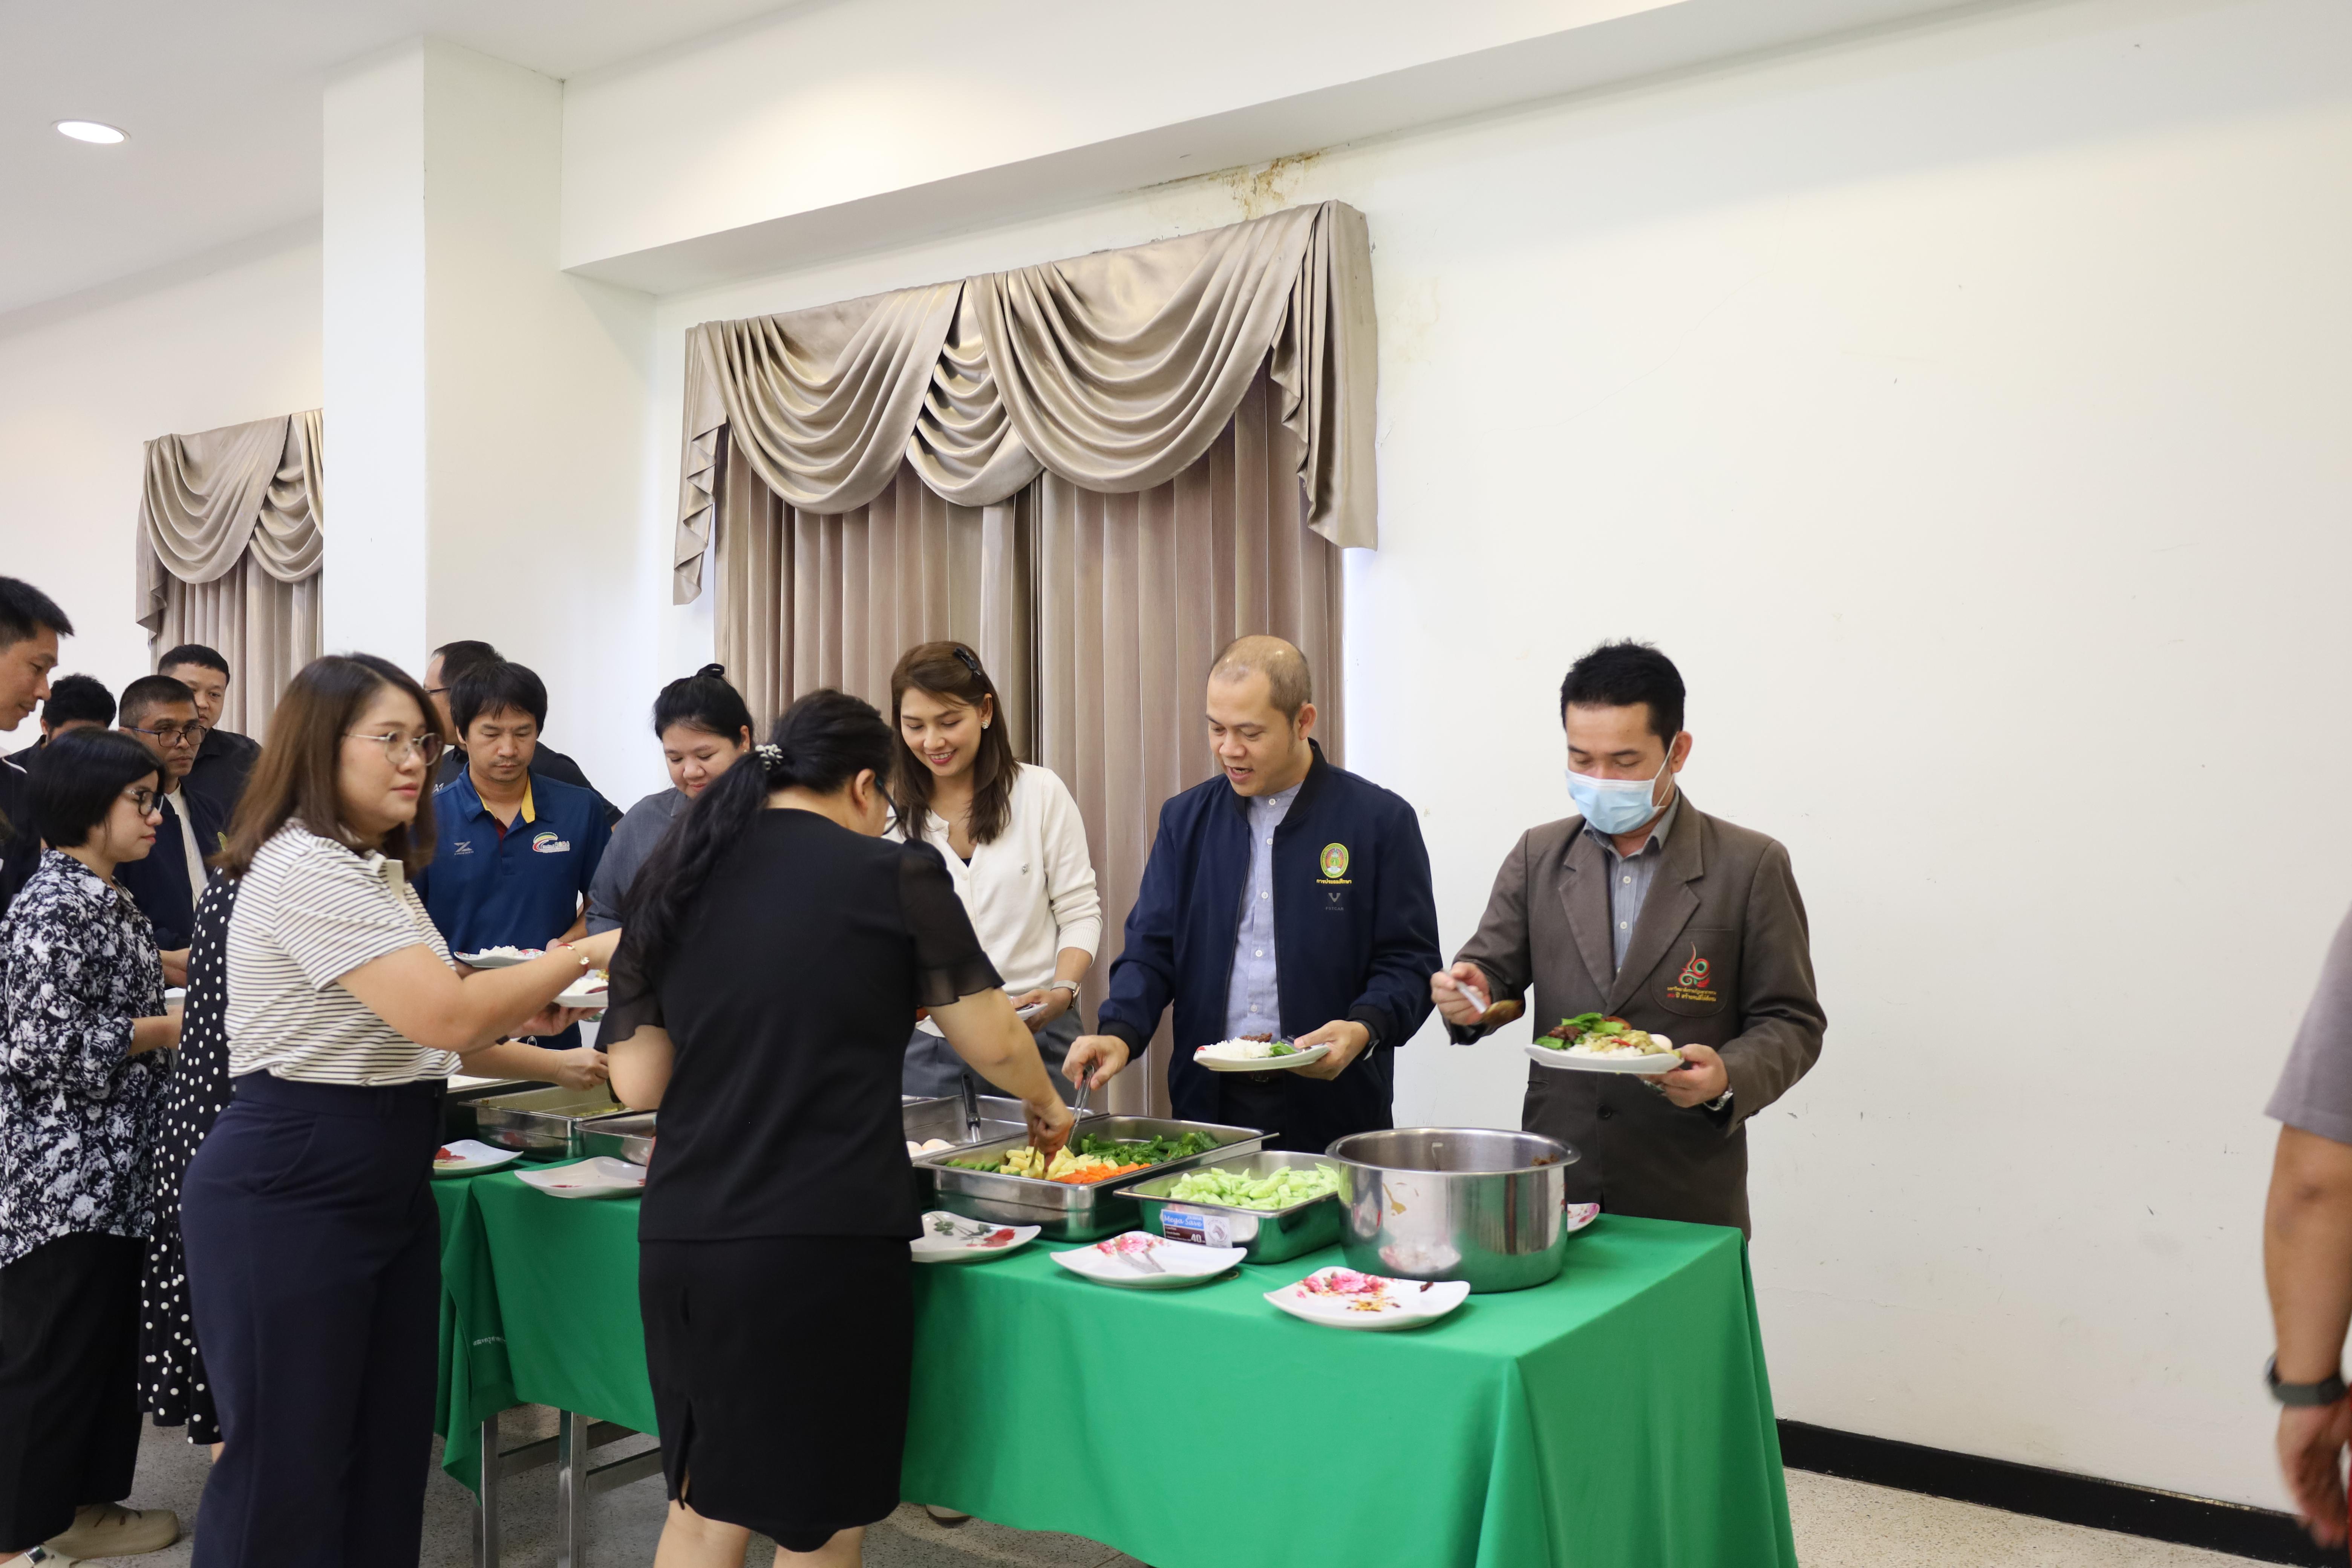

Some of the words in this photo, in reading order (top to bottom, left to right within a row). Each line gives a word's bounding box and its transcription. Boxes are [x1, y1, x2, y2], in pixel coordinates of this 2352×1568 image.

[1164, 1214, 1184, 1225] Mega
[1185, 1218, 1202, 1227] Save
[1191, 1233, 1202, 1243] 40
